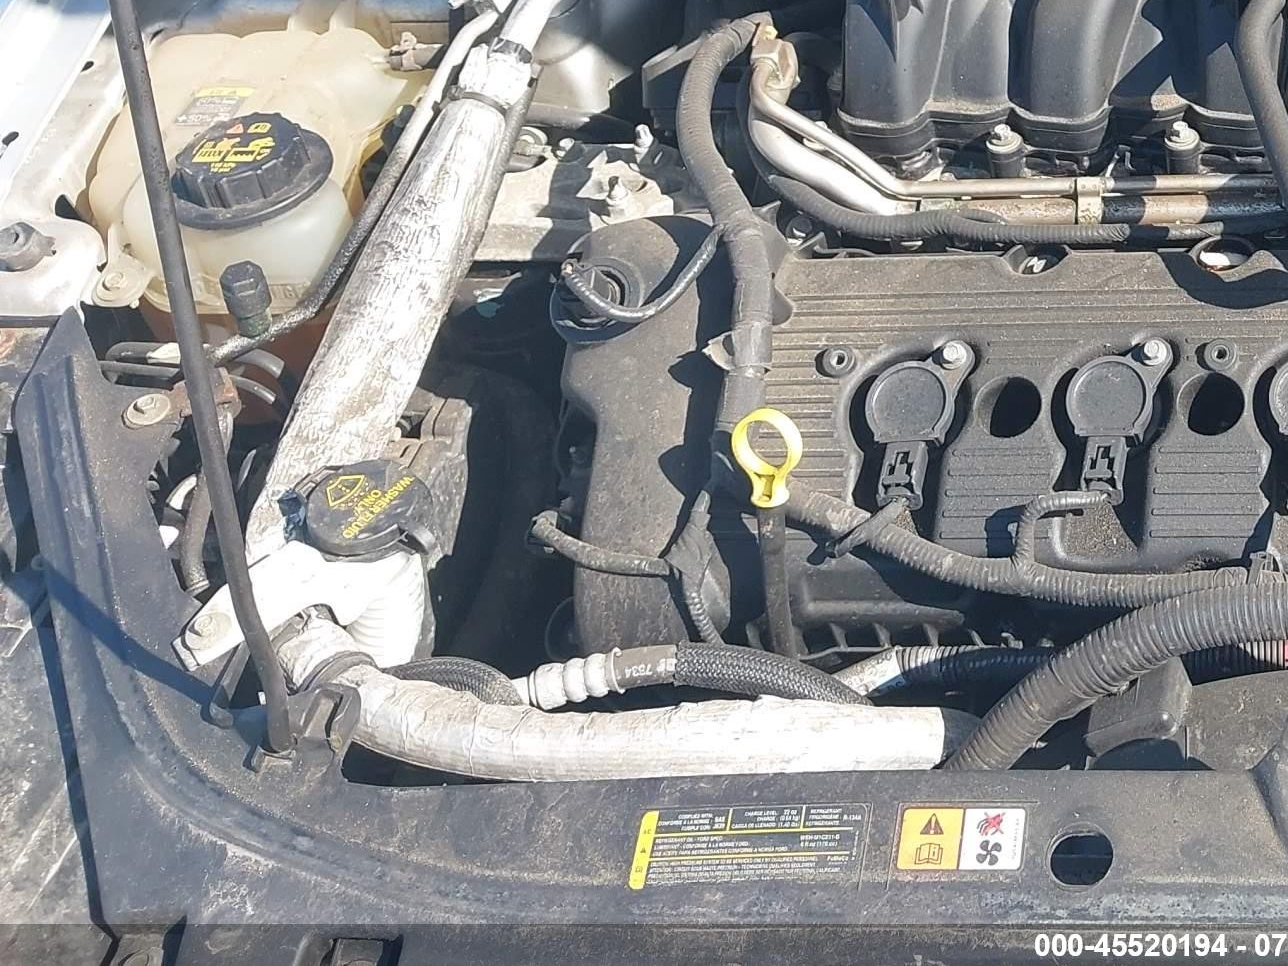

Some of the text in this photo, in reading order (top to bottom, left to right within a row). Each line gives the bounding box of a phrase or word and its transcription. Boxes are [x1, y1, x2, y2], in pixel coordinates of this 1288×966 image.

[342, 477, 415, 539] WASHER FLUID
[355, 490, 382, 516] ONLY
